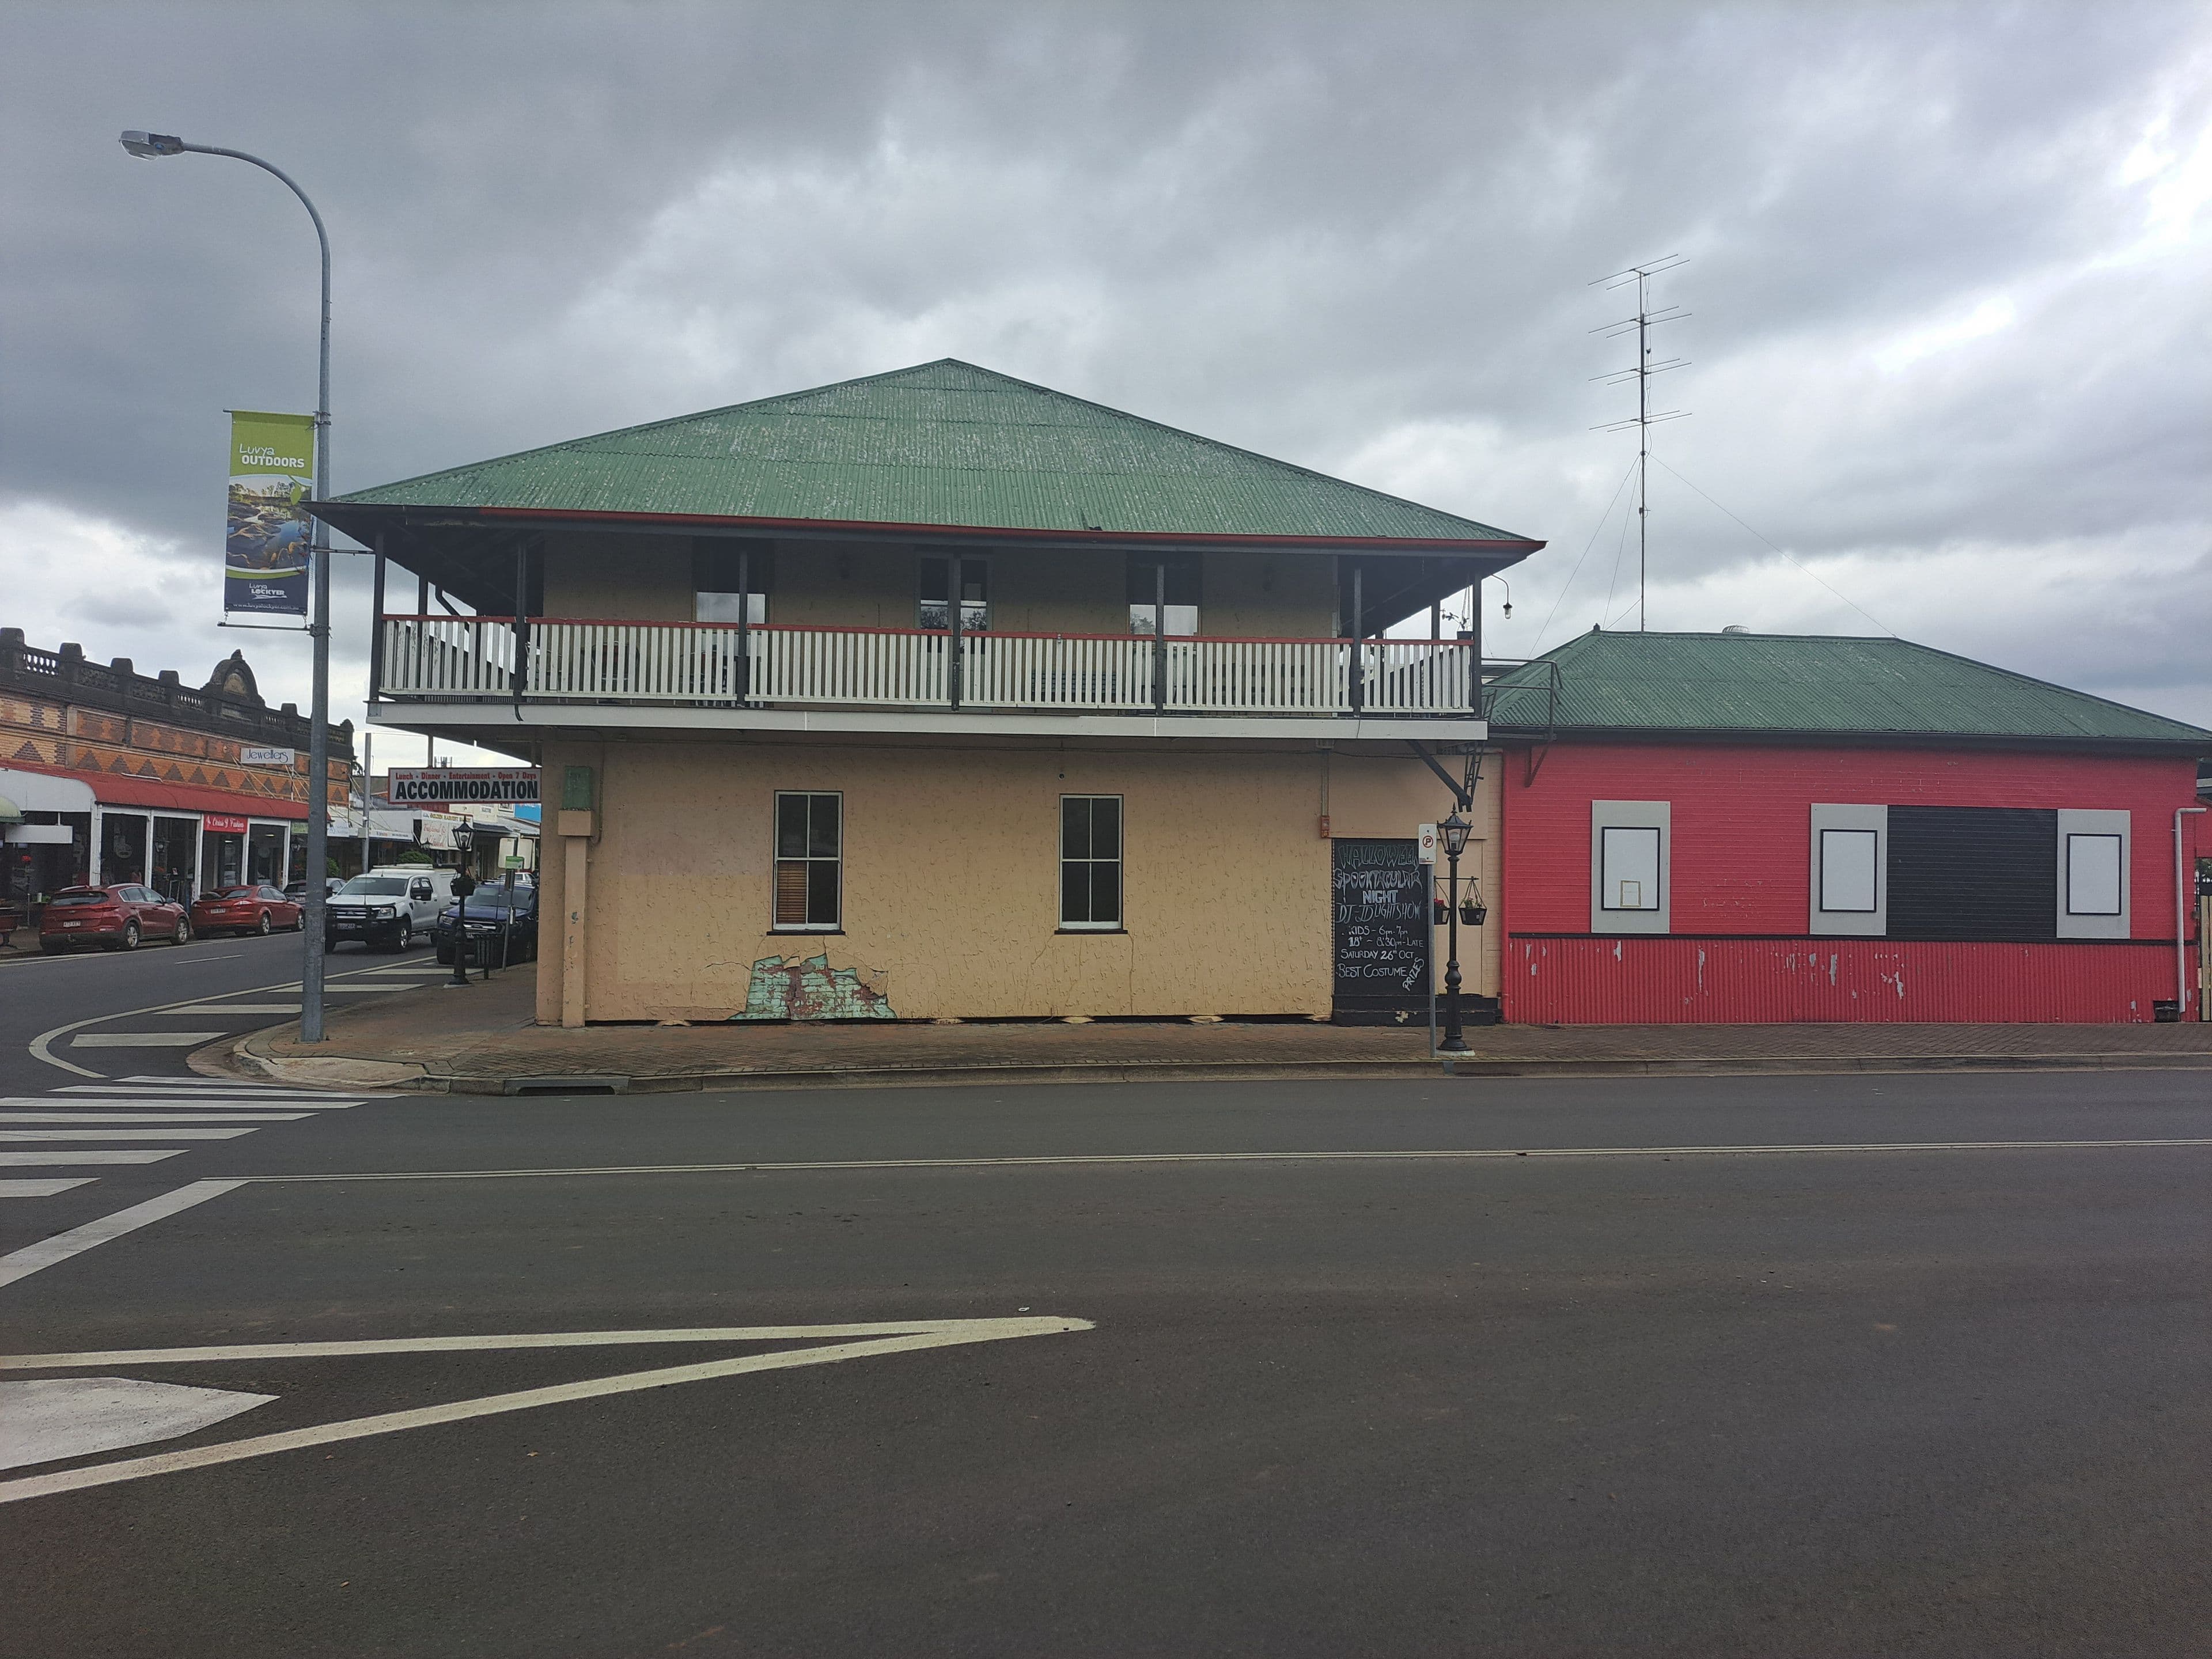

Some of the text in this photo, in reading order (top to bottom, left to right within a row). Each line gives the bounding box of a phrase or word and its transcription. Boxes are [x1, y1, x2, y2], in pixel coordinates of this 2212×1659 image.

[240, 443, 275, 457] Luvya
[242, 455, 305, 468] OUTDOORS
[247, 749, 289, 763] Jewellers
[449, 772, 490, 780] Entertainment
[498, 772, 513, 781] Open
[522, 772, 536, 781] Days
[395, 781, 538, 800] ACCOMMODATION
[1334, 868, 1423, 893] SPOOKTACULAR
[1363, 890, 1398, 904] NIGHT
[1349, 926, 1370, 935] KIDS
[1348, 936, 1362, 947] 18+
[1340, 949, 1378, 959] SATURDAY
[1399, 950, 1415, 959] OCT
[1337, 957, 1425, 991] BEST COSTUME PRIZES
